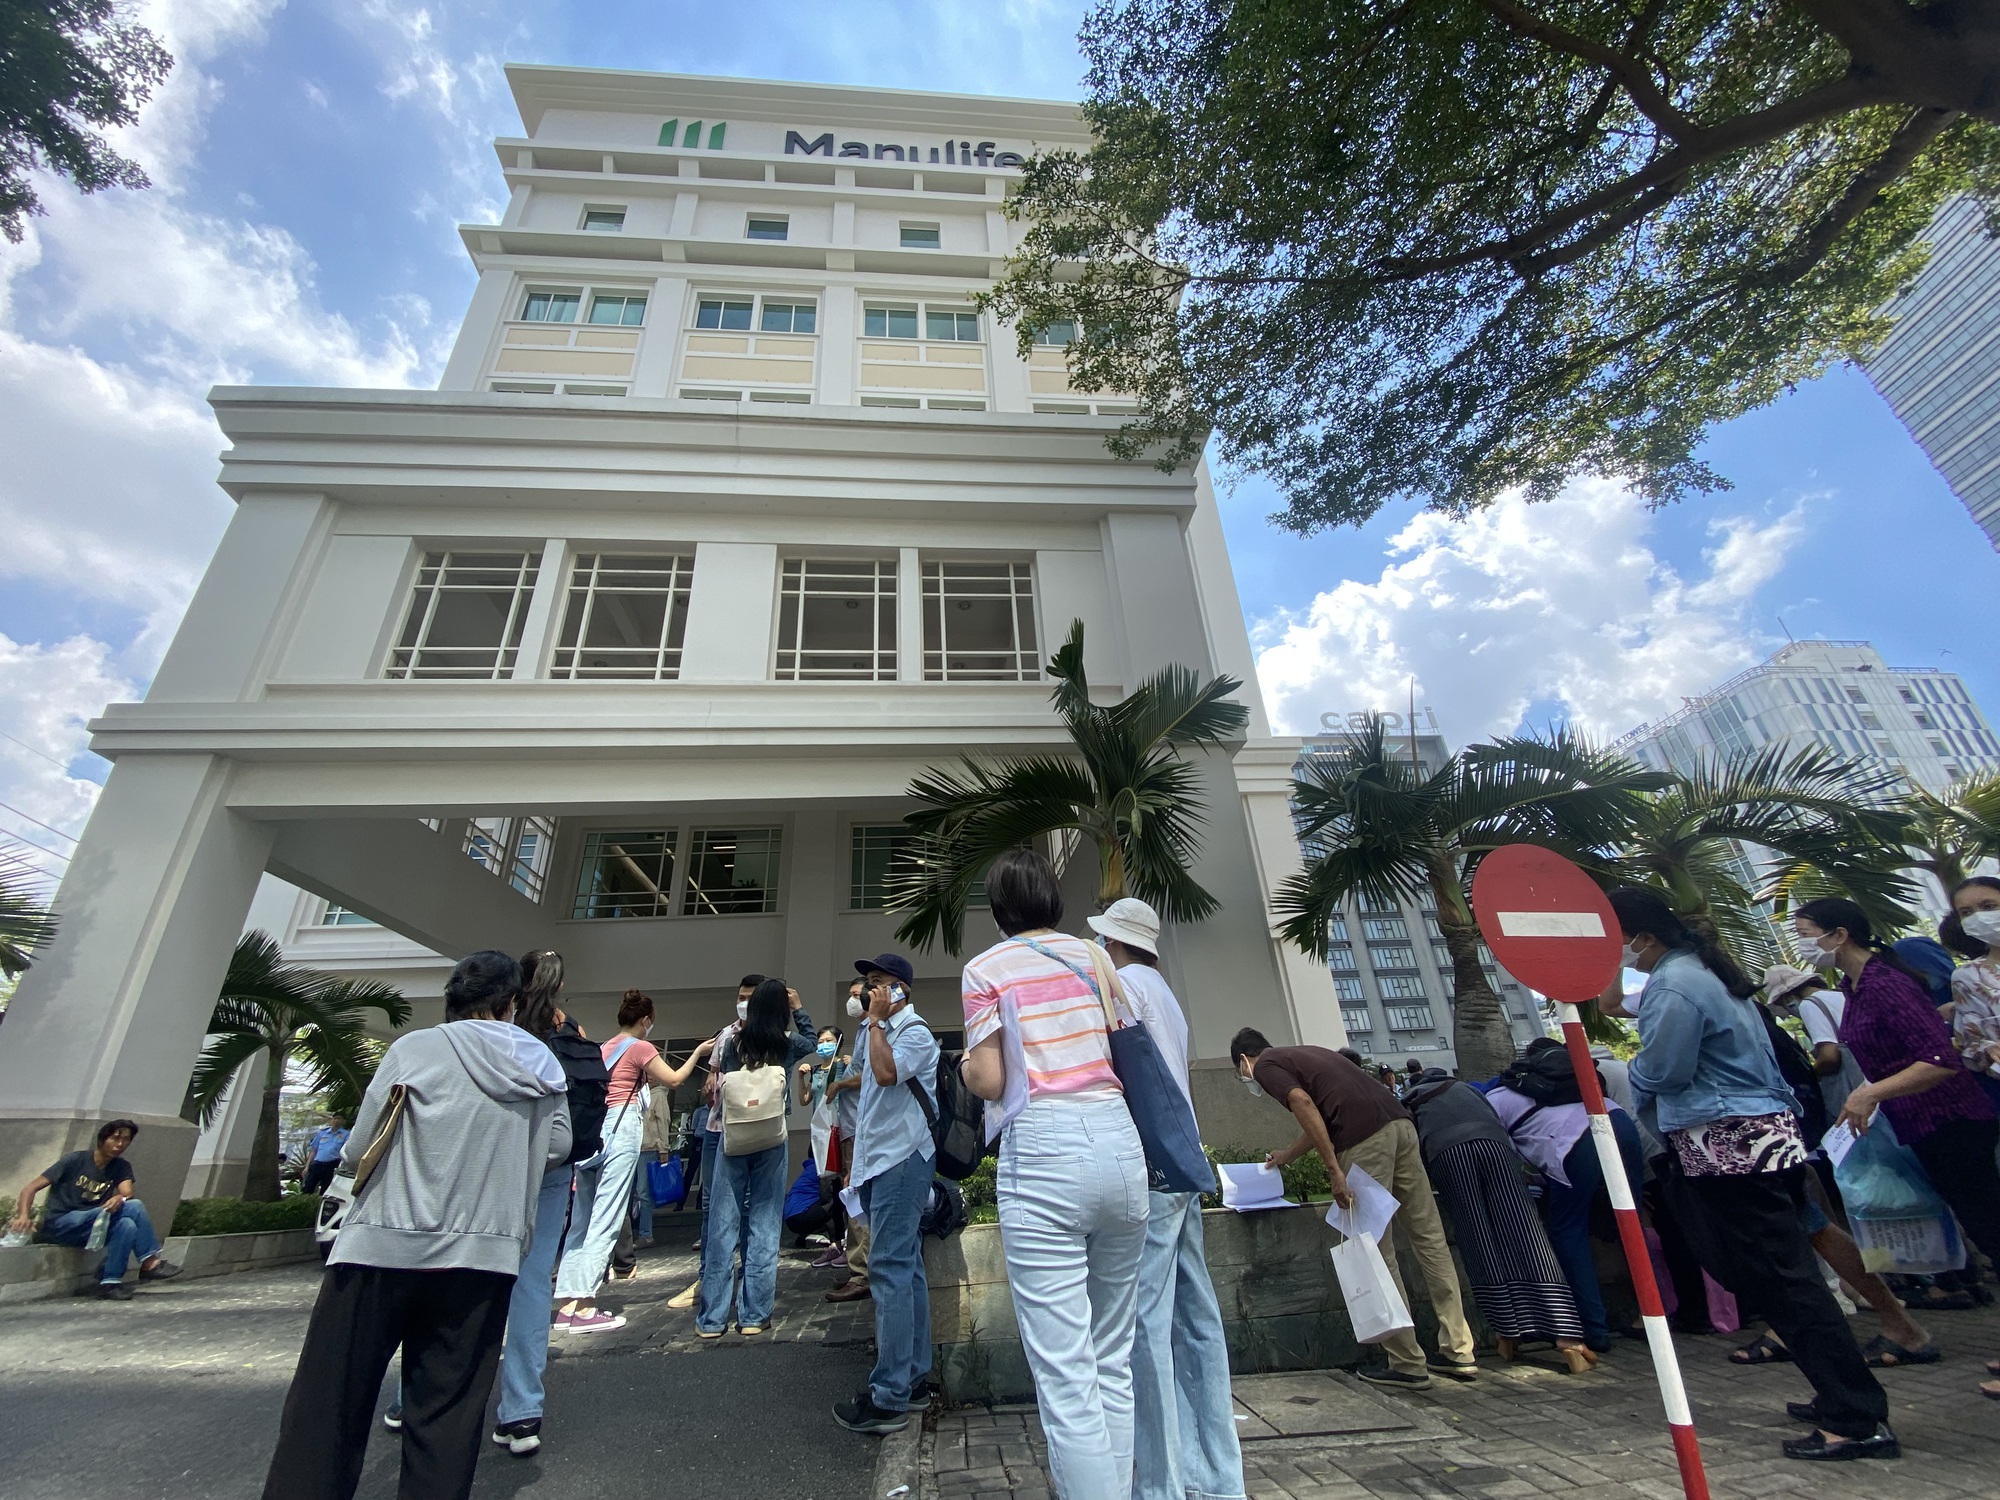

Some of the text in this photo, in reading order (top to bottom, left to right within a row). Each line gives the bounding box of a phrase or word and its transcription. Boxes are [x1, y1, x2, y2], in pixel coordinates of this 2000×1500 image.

[784, 130, 1025, 168] Manulife
[1320, 706, 1439, 736] capri
[1621, 722, 1649, 742] TOWER
